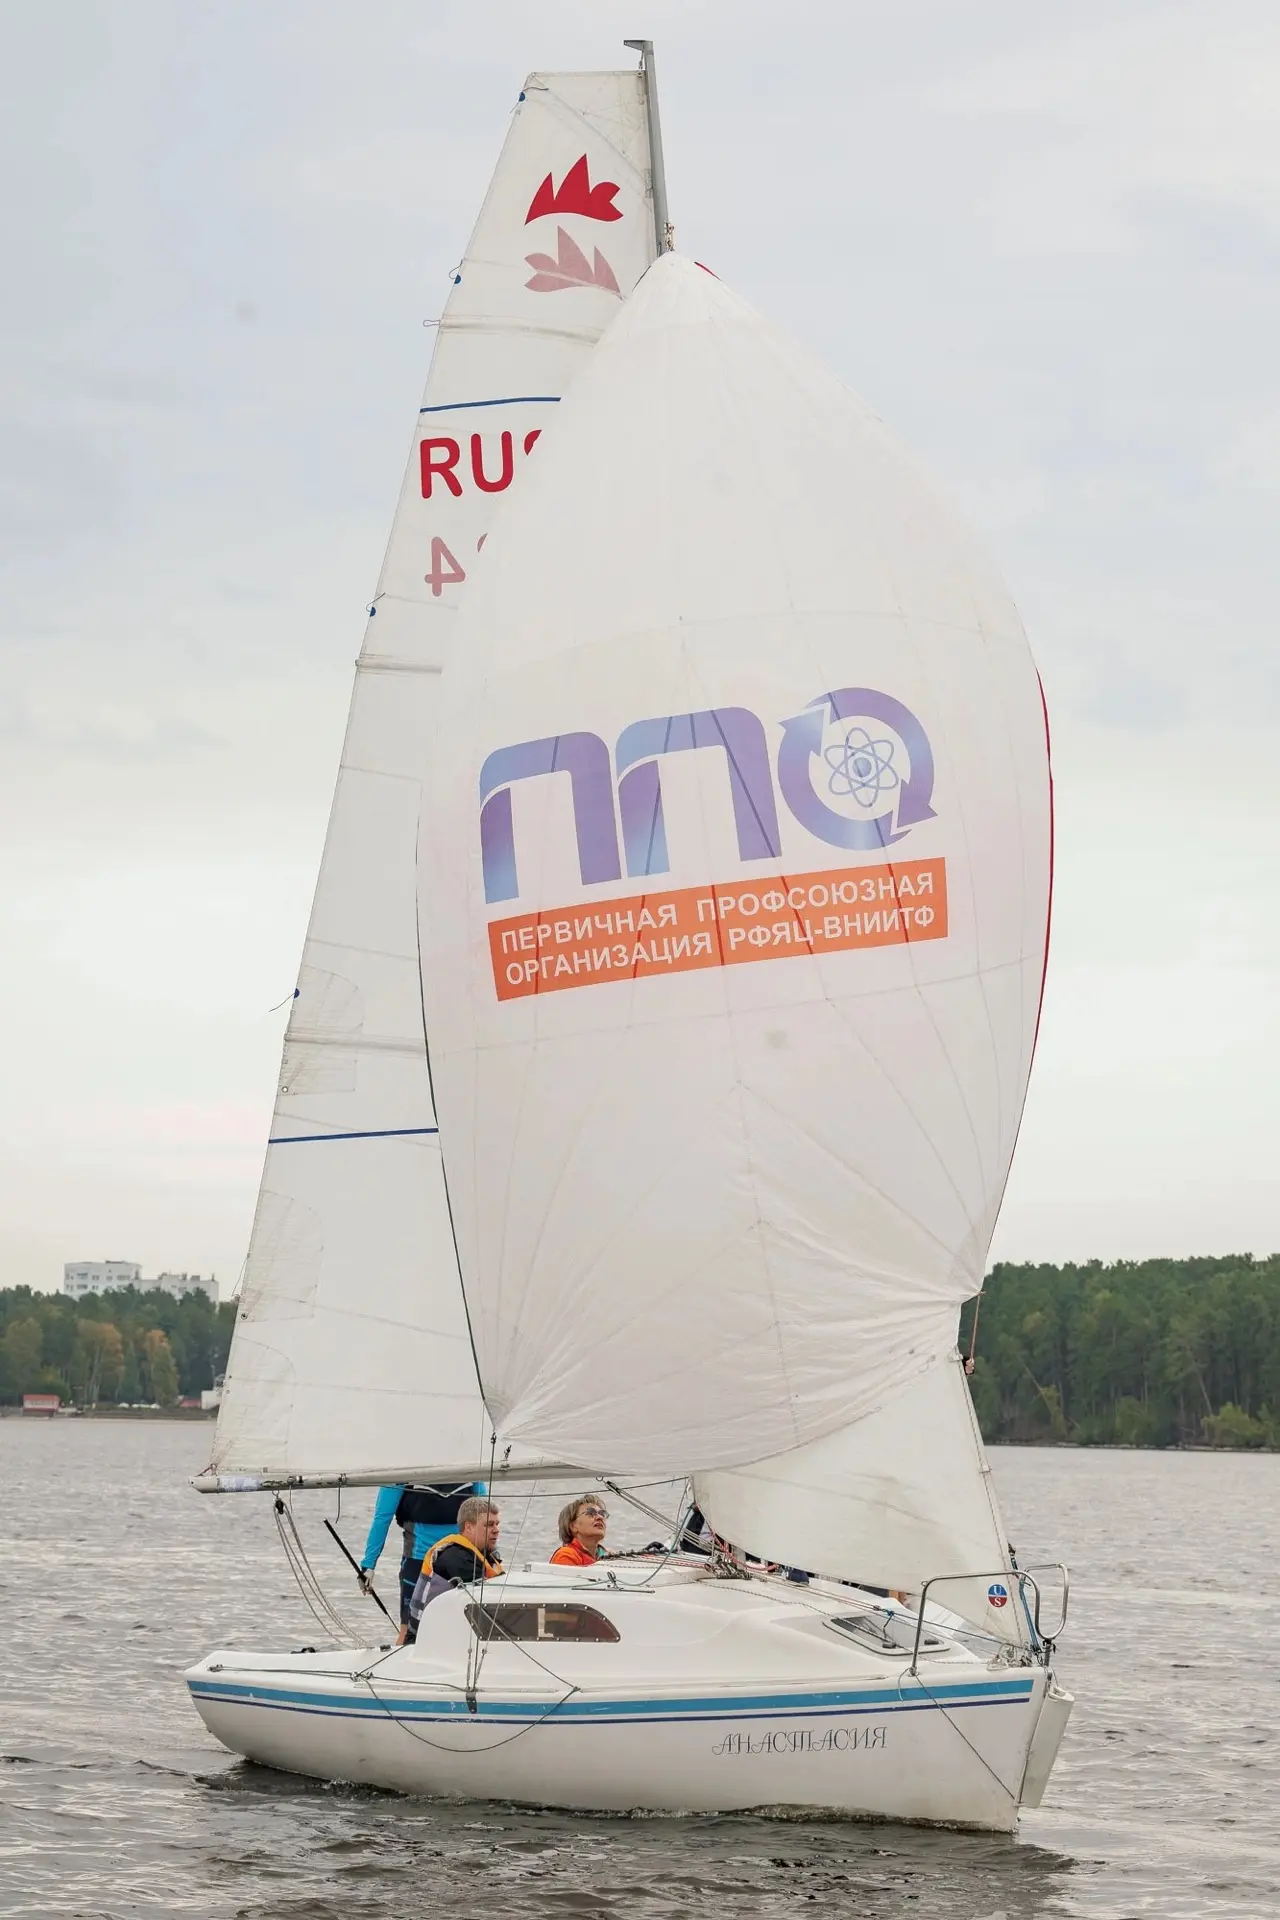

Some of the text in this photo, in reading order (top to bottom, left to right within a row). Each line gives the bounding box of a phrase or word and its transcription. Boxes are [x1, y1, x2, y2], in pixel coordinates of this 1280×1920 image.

[419, 429, 542, 499] RU
[501, 872, 933, 954] ПЕРВИЧНАЯ ПРОФСОЮЗНАЯ
[506, 905, 935, 985] ОРГАНИЗАЦИЯ РФЯЦ-ВНИИТФ
[711, 1726, 888, 1756] АНАСТАСИЯ
